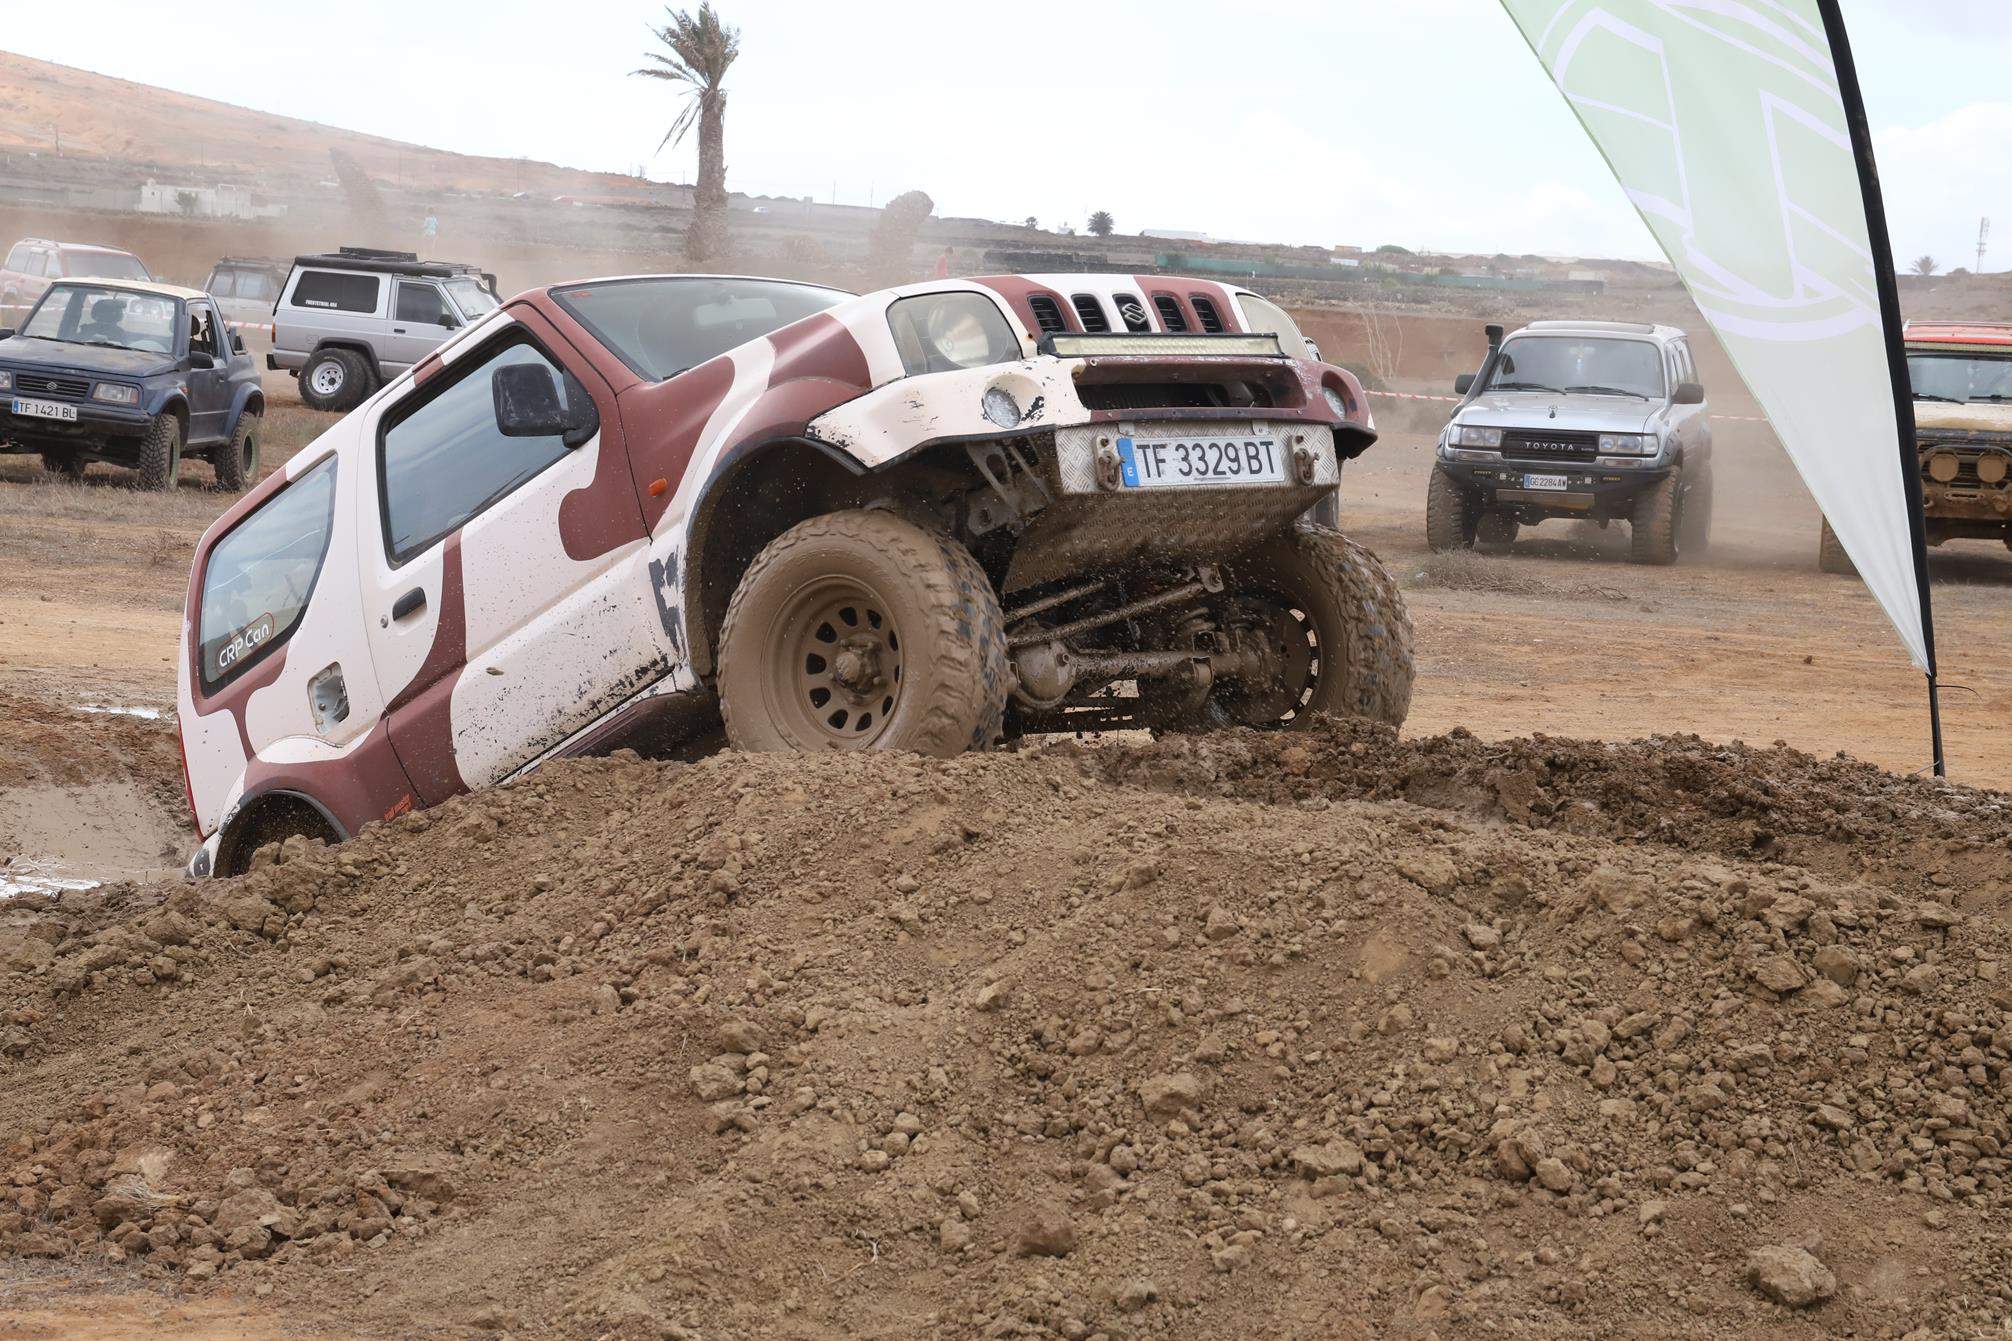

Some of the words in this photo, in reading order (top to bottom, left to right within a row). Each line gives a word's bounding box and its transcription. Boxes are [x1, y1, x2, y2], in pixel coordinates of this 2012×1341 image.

[20, 402, 31, 413] TF
[35, 404, 59, 417] 1421
[62, 407, 75, 419] BL
[1136, 443, 1168, 478] TF
[1175, 442, 1241, 477] 3329
[1244, 441, 1275, 475] BT
[1525, 441, 1574, 451] TOYOTA
[219, 637, 243, 668] CRP
[245, 623, 269, 648] Can
